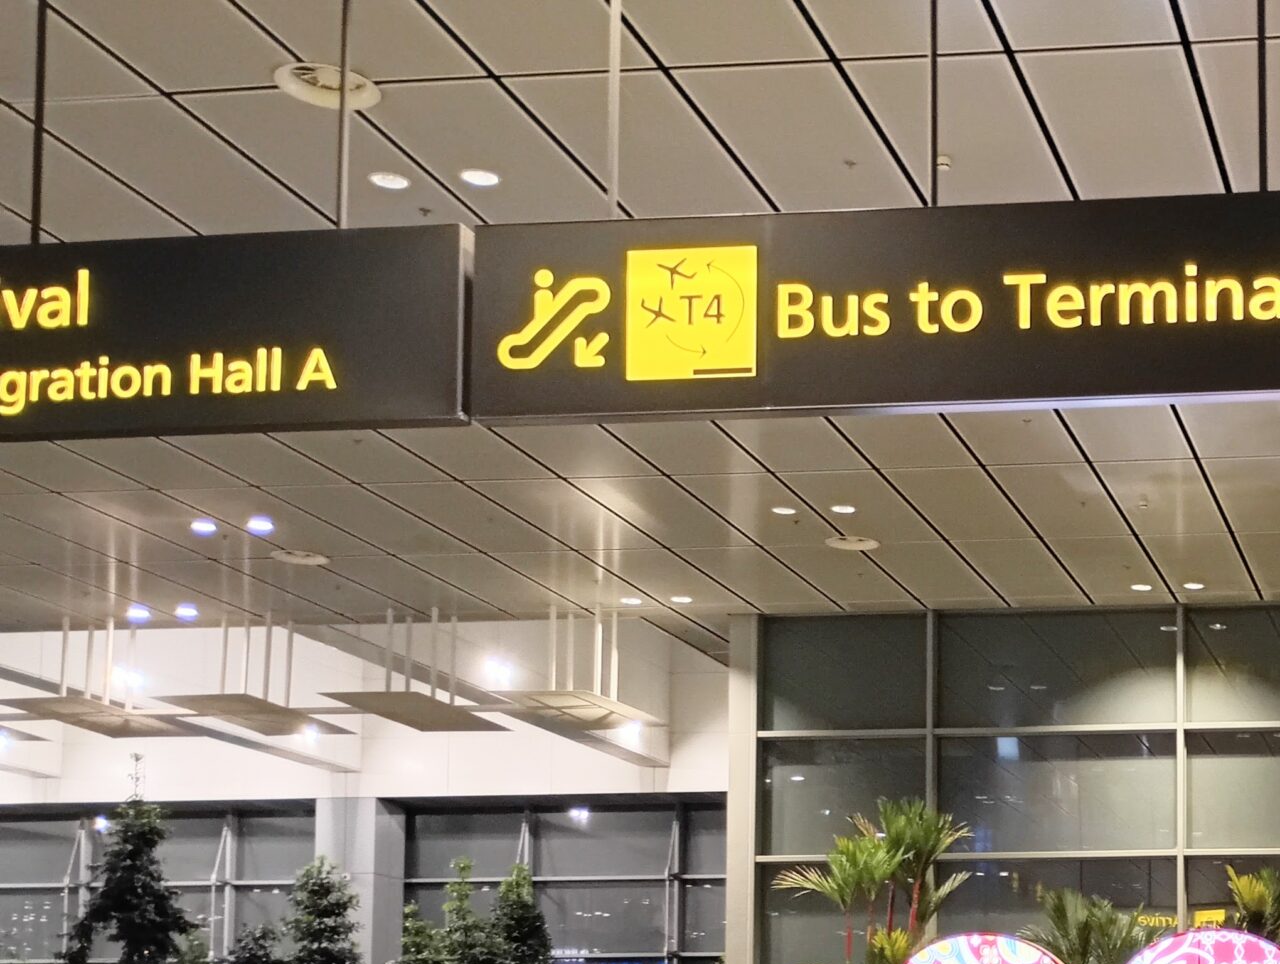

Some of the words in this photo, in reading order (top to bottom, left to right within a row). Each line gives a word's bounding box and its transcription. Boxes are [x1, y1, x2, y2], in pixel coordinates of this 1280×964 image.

[679, 293, 726, 325] T4
[776, 283, 891, 339] Bus
[909, 281, 983, 334] to
[0, 355, 172, 416] gration
[189, 346, 282, 395] Hall
[295, 347, 337, 391] A
